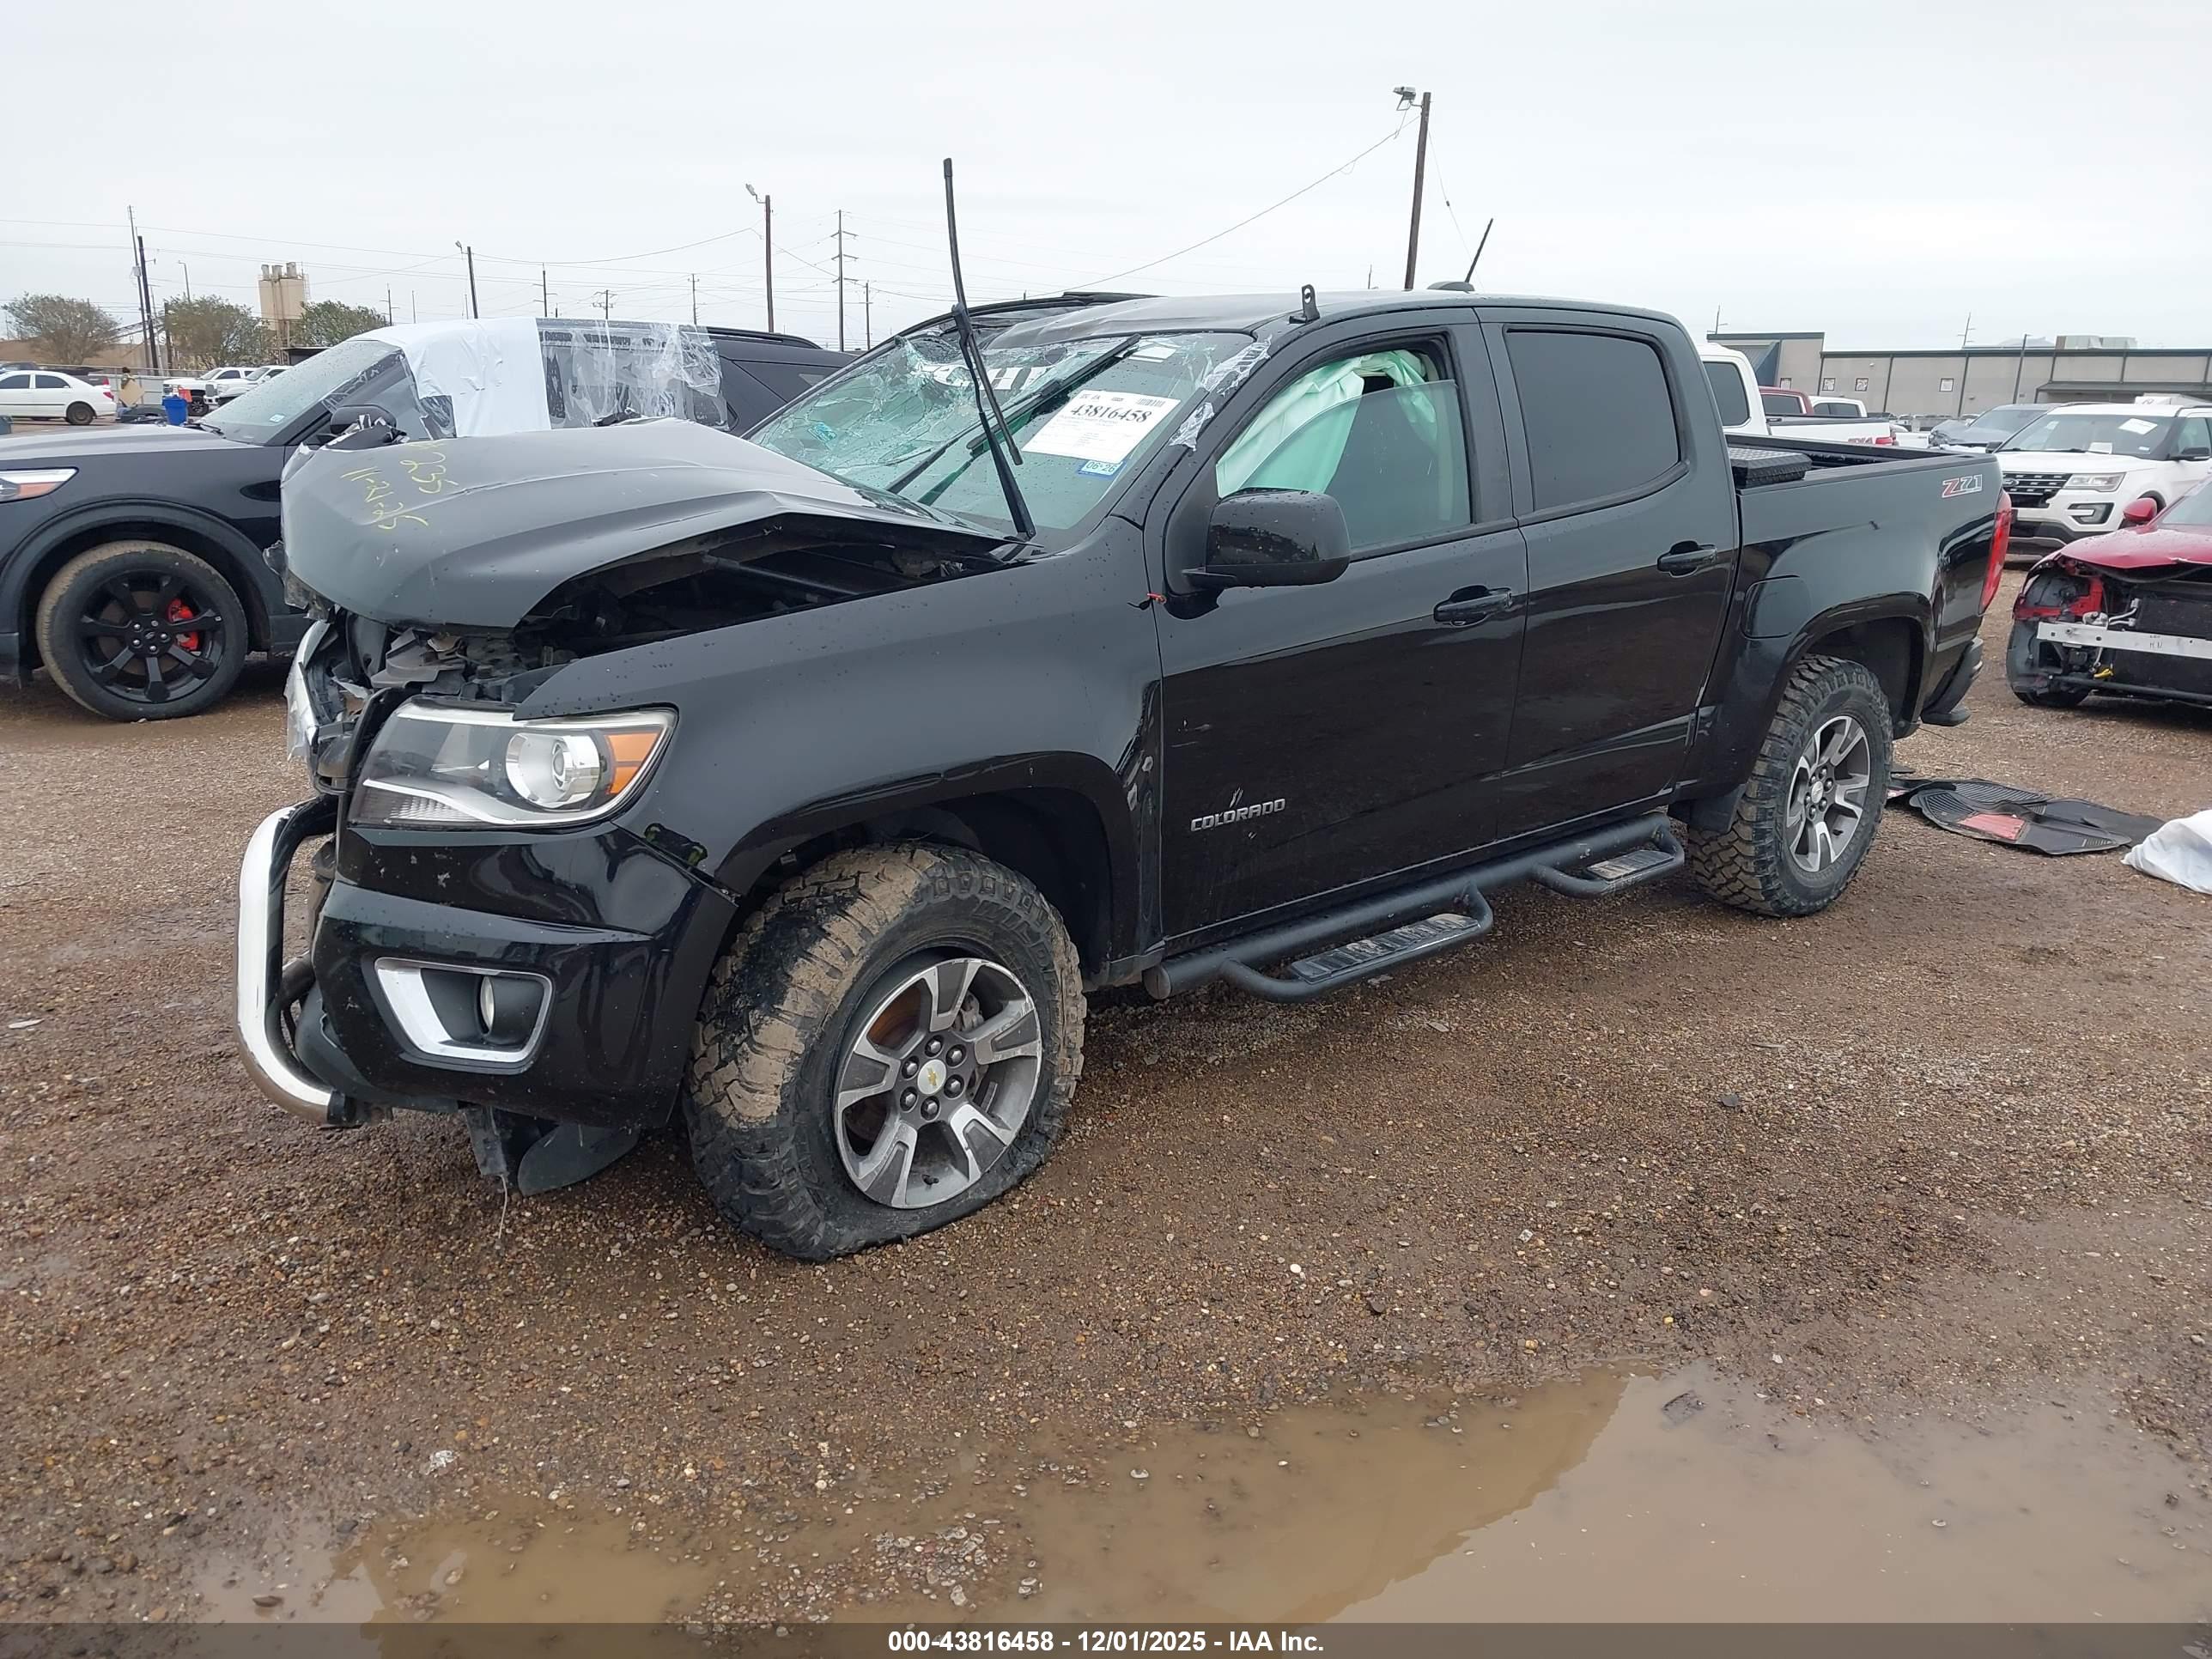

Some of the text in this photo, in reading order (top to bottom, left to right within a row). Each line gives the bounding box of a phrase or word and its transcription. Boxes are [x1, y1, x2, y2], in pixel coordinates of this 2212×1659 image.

[1071, 404, 1152, 423] 43816458
[1942, 474, 1983, 498] Z71
[1191, 798, 1285, 832] COLORADO
